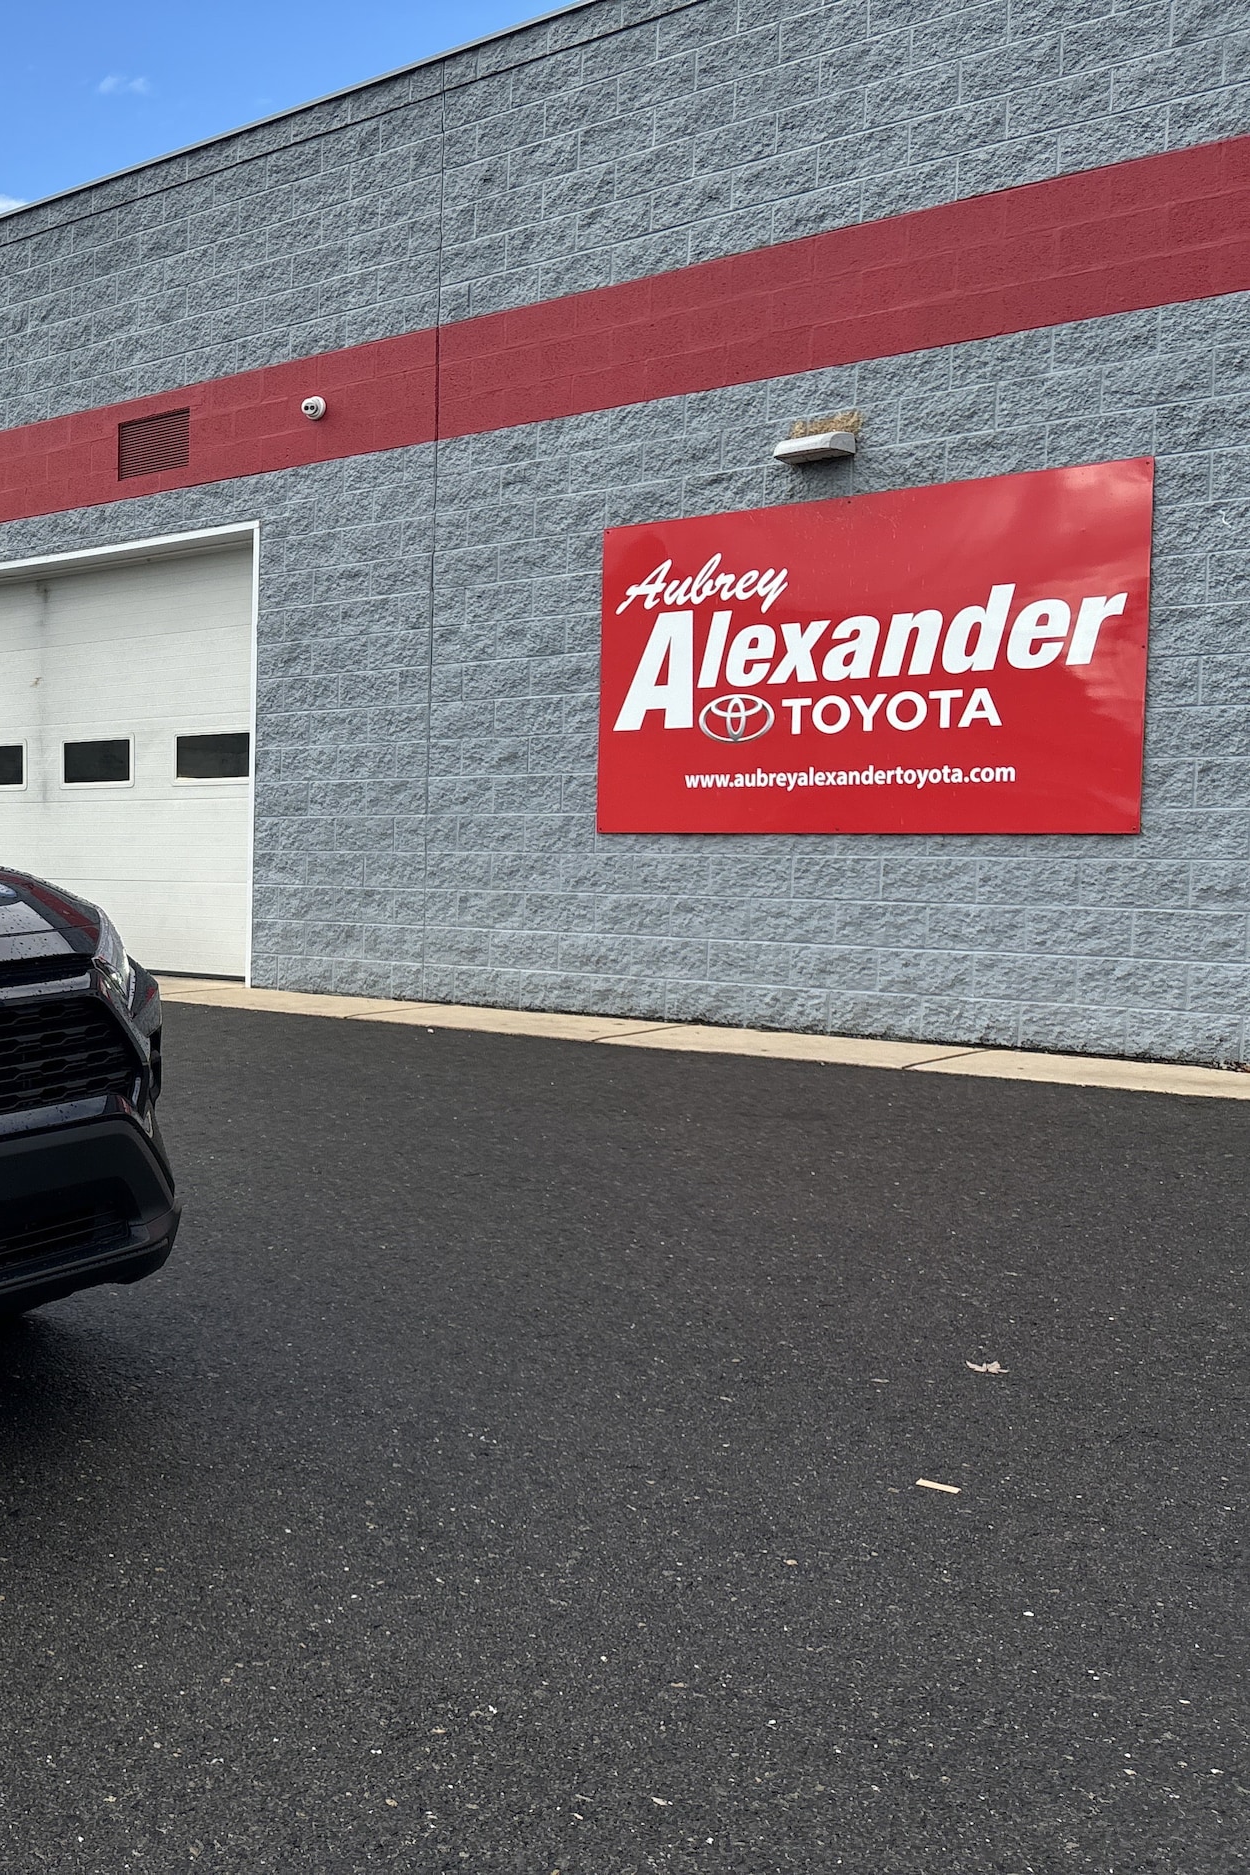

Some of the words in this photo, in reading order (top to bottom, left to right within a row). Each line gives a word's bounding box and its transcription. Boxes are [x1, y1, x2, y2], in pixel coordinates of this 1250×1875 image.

[615, 552, 789, 614] Aubrey
[613, 583, 1128, 732] Alexander
[781, 688, 1003, 735] TOYOTA
[684, 764, 1016, 792] www.aubreyalexandertoyota.com
